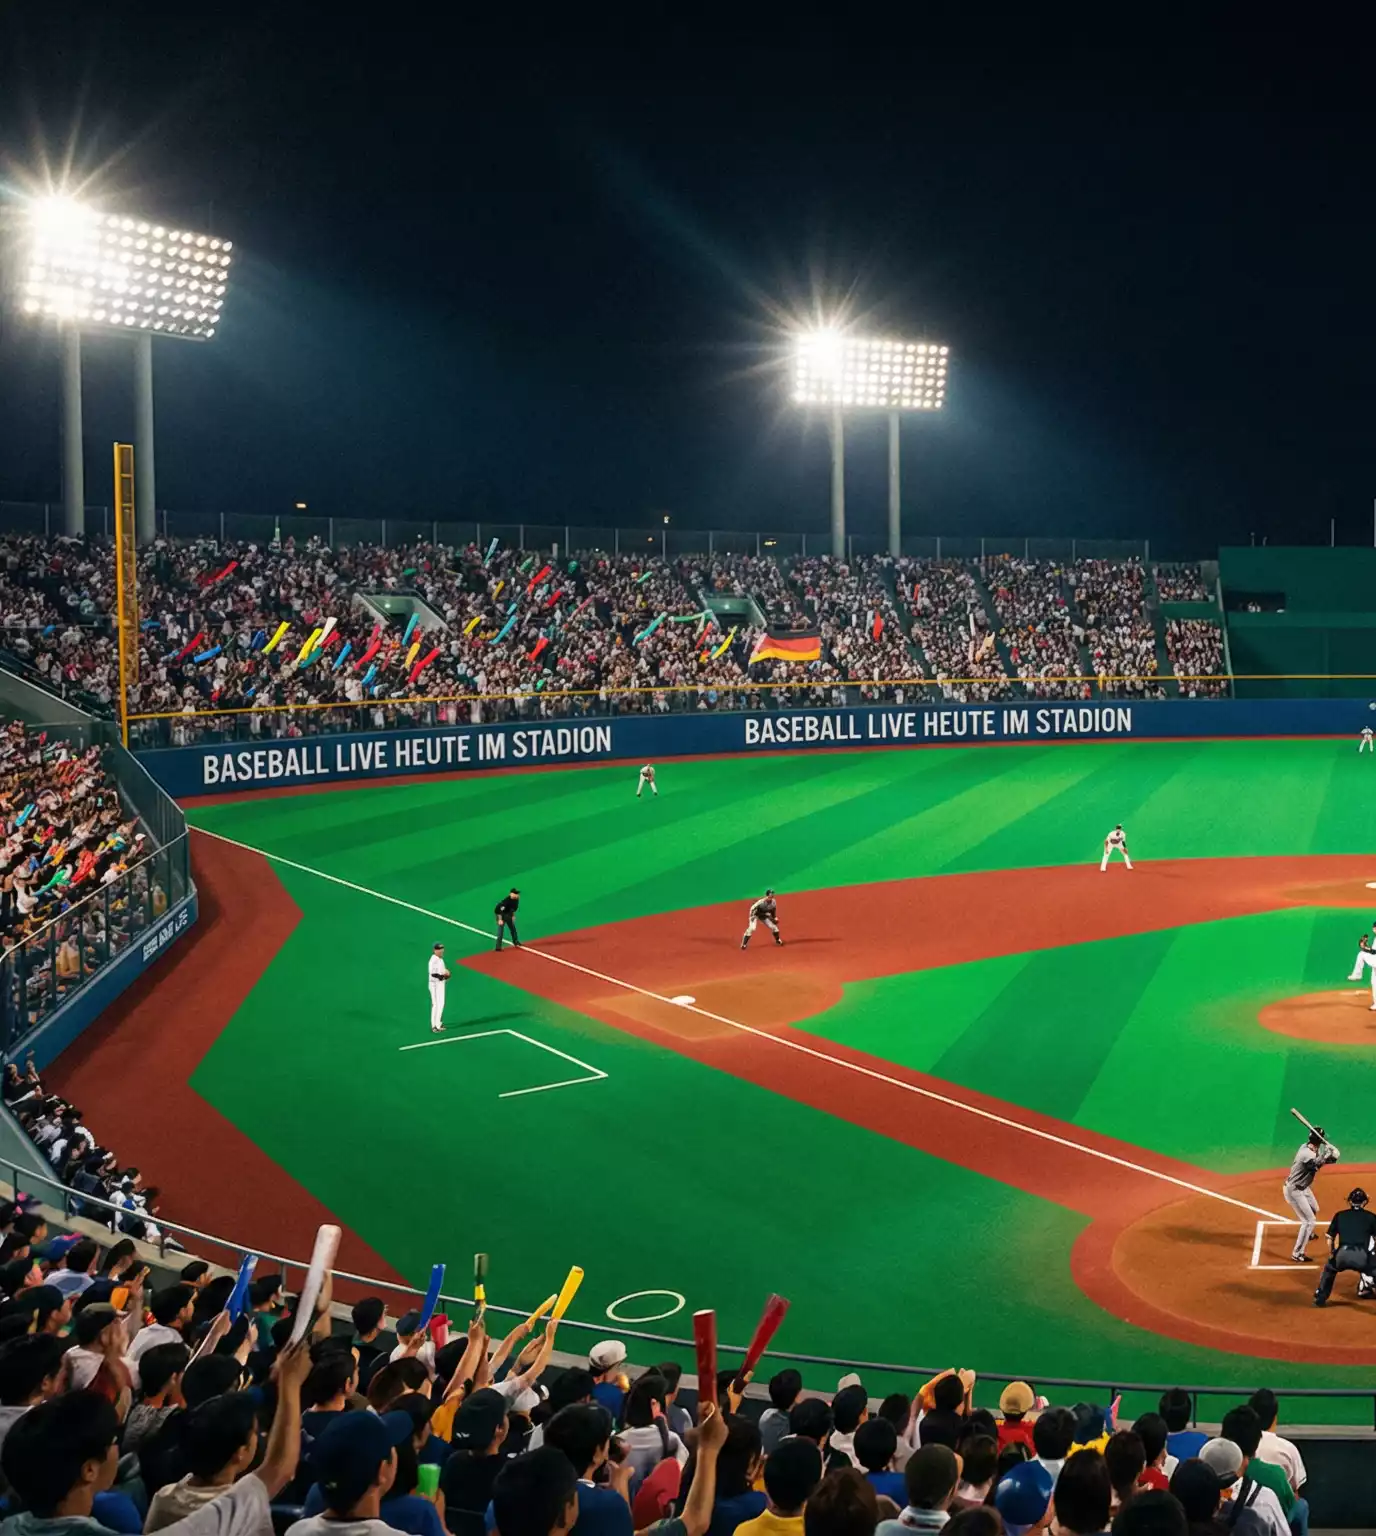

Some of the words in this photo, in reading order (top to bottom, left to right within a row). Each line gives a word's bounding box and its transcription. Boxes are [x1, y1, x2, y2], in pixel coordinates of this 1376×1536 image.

[745, 713, 862, 745] BASEBALL
[868, 710, 917, 739] LIVE
[924, 709, 996, 737] HEUTE
[1003, 709, 1029, 734] IM
[1035, 707, 1132, 734] STADION
[203, 745, 329, 785] BASEBALL
[336, 740, 388, 772] LIVE
[395, 735, 471, 767] HEUTE
[478, 732, 506, 761] IM
[512, 725, 611, 758] STADION
